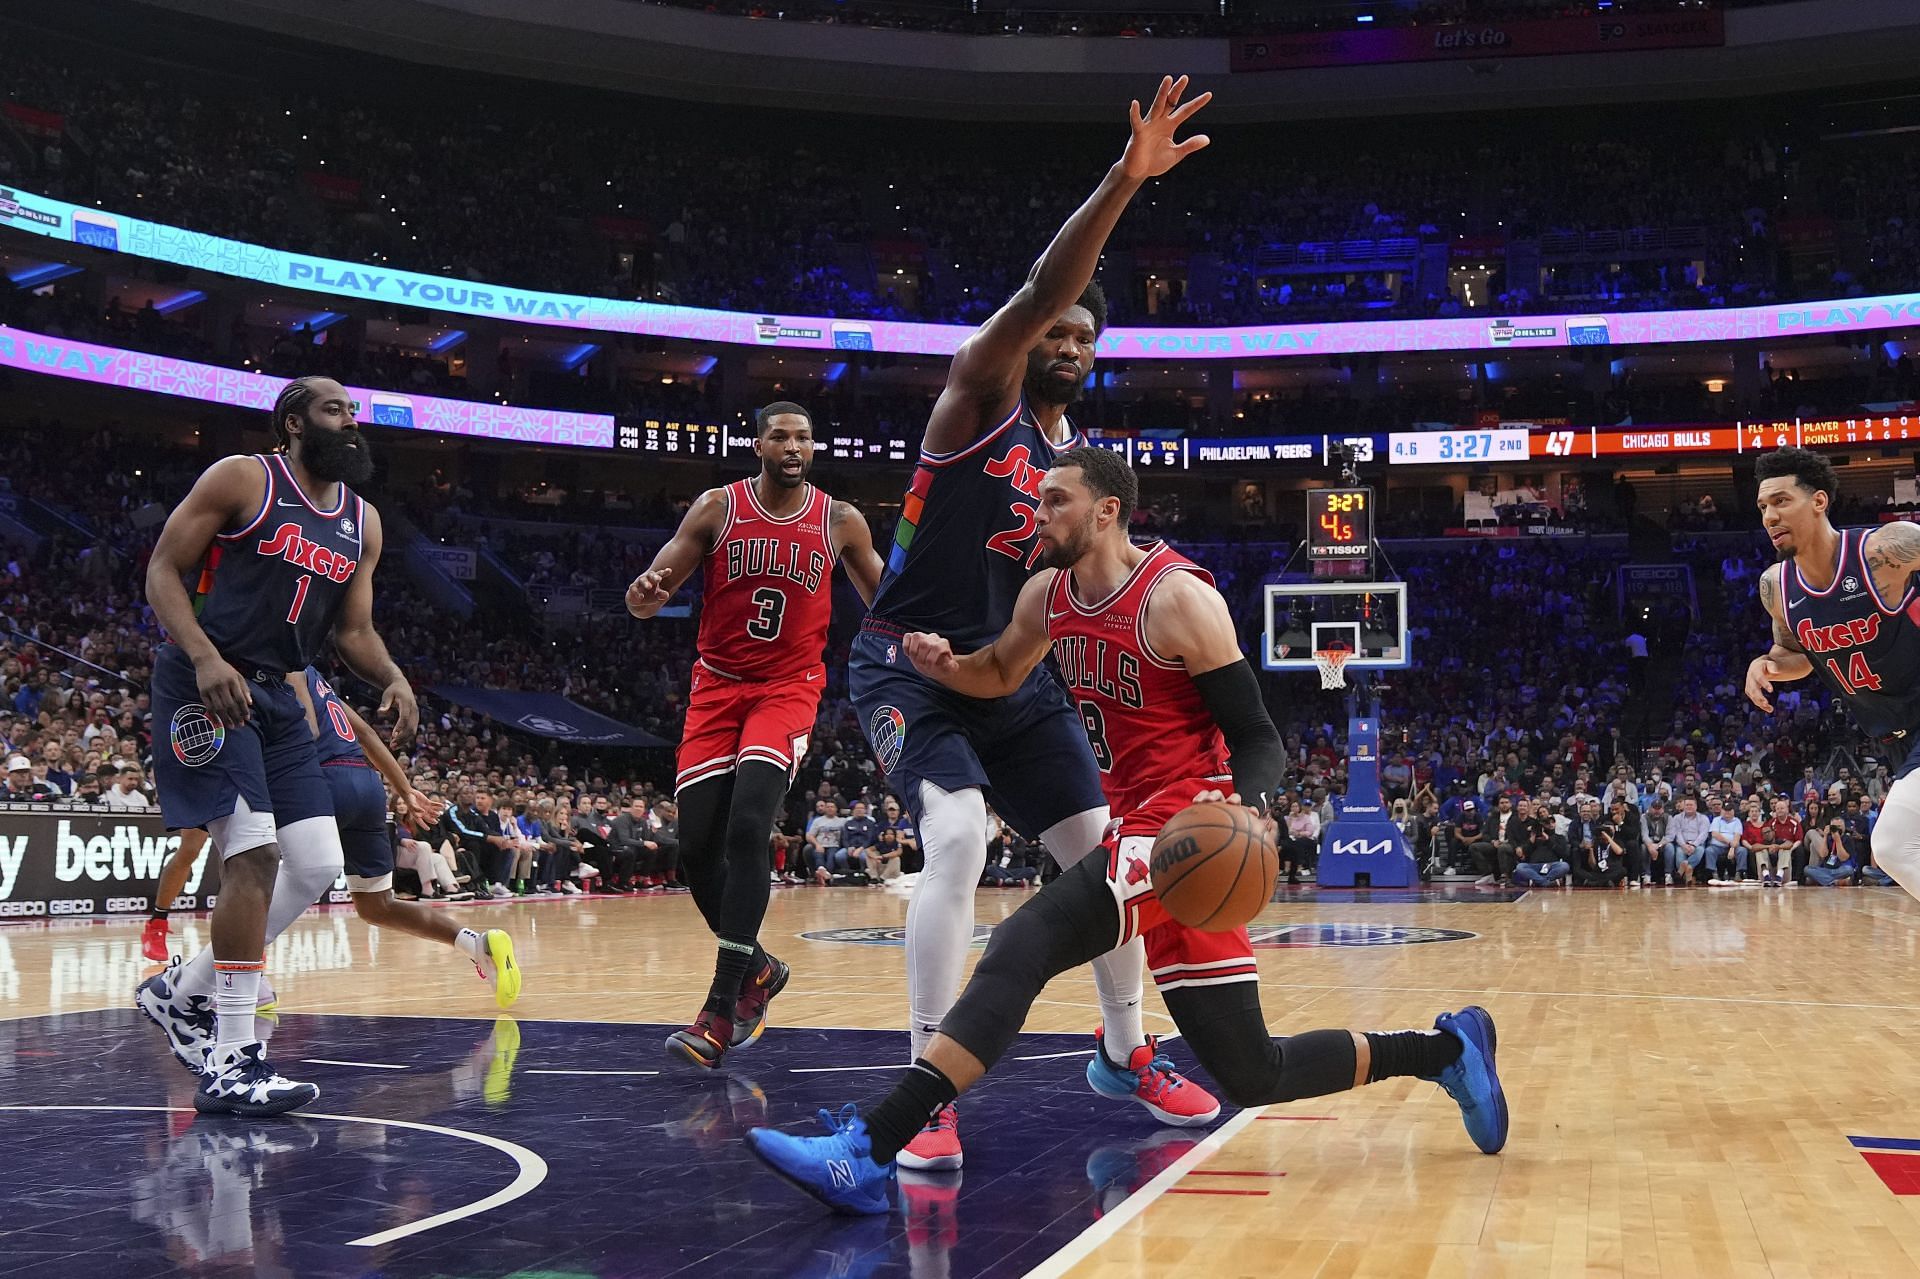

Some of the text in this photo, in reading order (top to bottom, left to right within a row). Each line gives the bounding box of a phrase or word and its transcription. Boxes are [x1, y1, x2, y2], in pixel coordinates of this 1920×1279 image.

[1435, 27, 1505, 48] Let's Go
[18, 207, 58, 225] ONLINE
[289, 262, 386, 292] PLAY
[396, 278, 494, 310] YOUR
[503, 295, 585, 321] WAY
[1777, 305, 1871, 329] PLAY
[1136, 335, 1233, 352] YOUR
[1241, 330, 1320, 350] WAY
[1514, 328, 1554, 337] ONLINE
[24, 339, 116, 375] WAY
[666, 422, 680, 431] AST
[1748, 422, 1790, 434] FLS TOL
[1804, 416, 1908, 432] PLAYER 11 3 8 0
[620, 426, 717, 444] PHI 12 12 1 4
[728, 436, 751, 448] 8:00
[1545, 431, 1575, 456] 47
[1622, 432, 1711, 449] CHICAGO BULLS
[1751, 434, 1787, 449] 4 6
[1805, 429, 1908, 445] POINTS 11 4 6 5
[620, 438, 639, 449] CHI
[645, 440, 659, 450] 22
[666, 442, 679, 452] 10
[690, 443, 696, 453] 1
[1137, 441, 1178, 451] FLS TOL
[1199, 443, 1312, 461] PHILADELPHIA 76ERS
[1395, 434, 1522, 459] 4.6 3:27 2ND
[1140, 453, 1175, 466] 4 5
[983, 444, 1048, 500] Six
[1327, 493, 1364, 512] 3:27
[1321, 514, 1352, 540] 4.5
[257, 522, 357, 584] Sixers
[423, 550, 469, 563] EICO
[1327, 545, 1368, 555] TISSOT
[727, 538, 825, 595] BULLS
[286, 574, 311, 625] 1
[746, 587, 787, 642] 3
[1104, 612, 1134, 624] ZENNI
[1797, 612, 1882, 653] Sixers
[1826, 651, 1883, 695] 14
[326, 700, 355, 742] 0
[1079, 700, 1114, 774] 8
[0, 901, 46, 917] GEICO
[50, 899, 94, 914] GEICO
[106, 897, 148, 912] GEICO
[171, 896, 197, 910] ICO
[329, 890, 352, 903] GEIC
[826, 1159, 857, 1189] N
